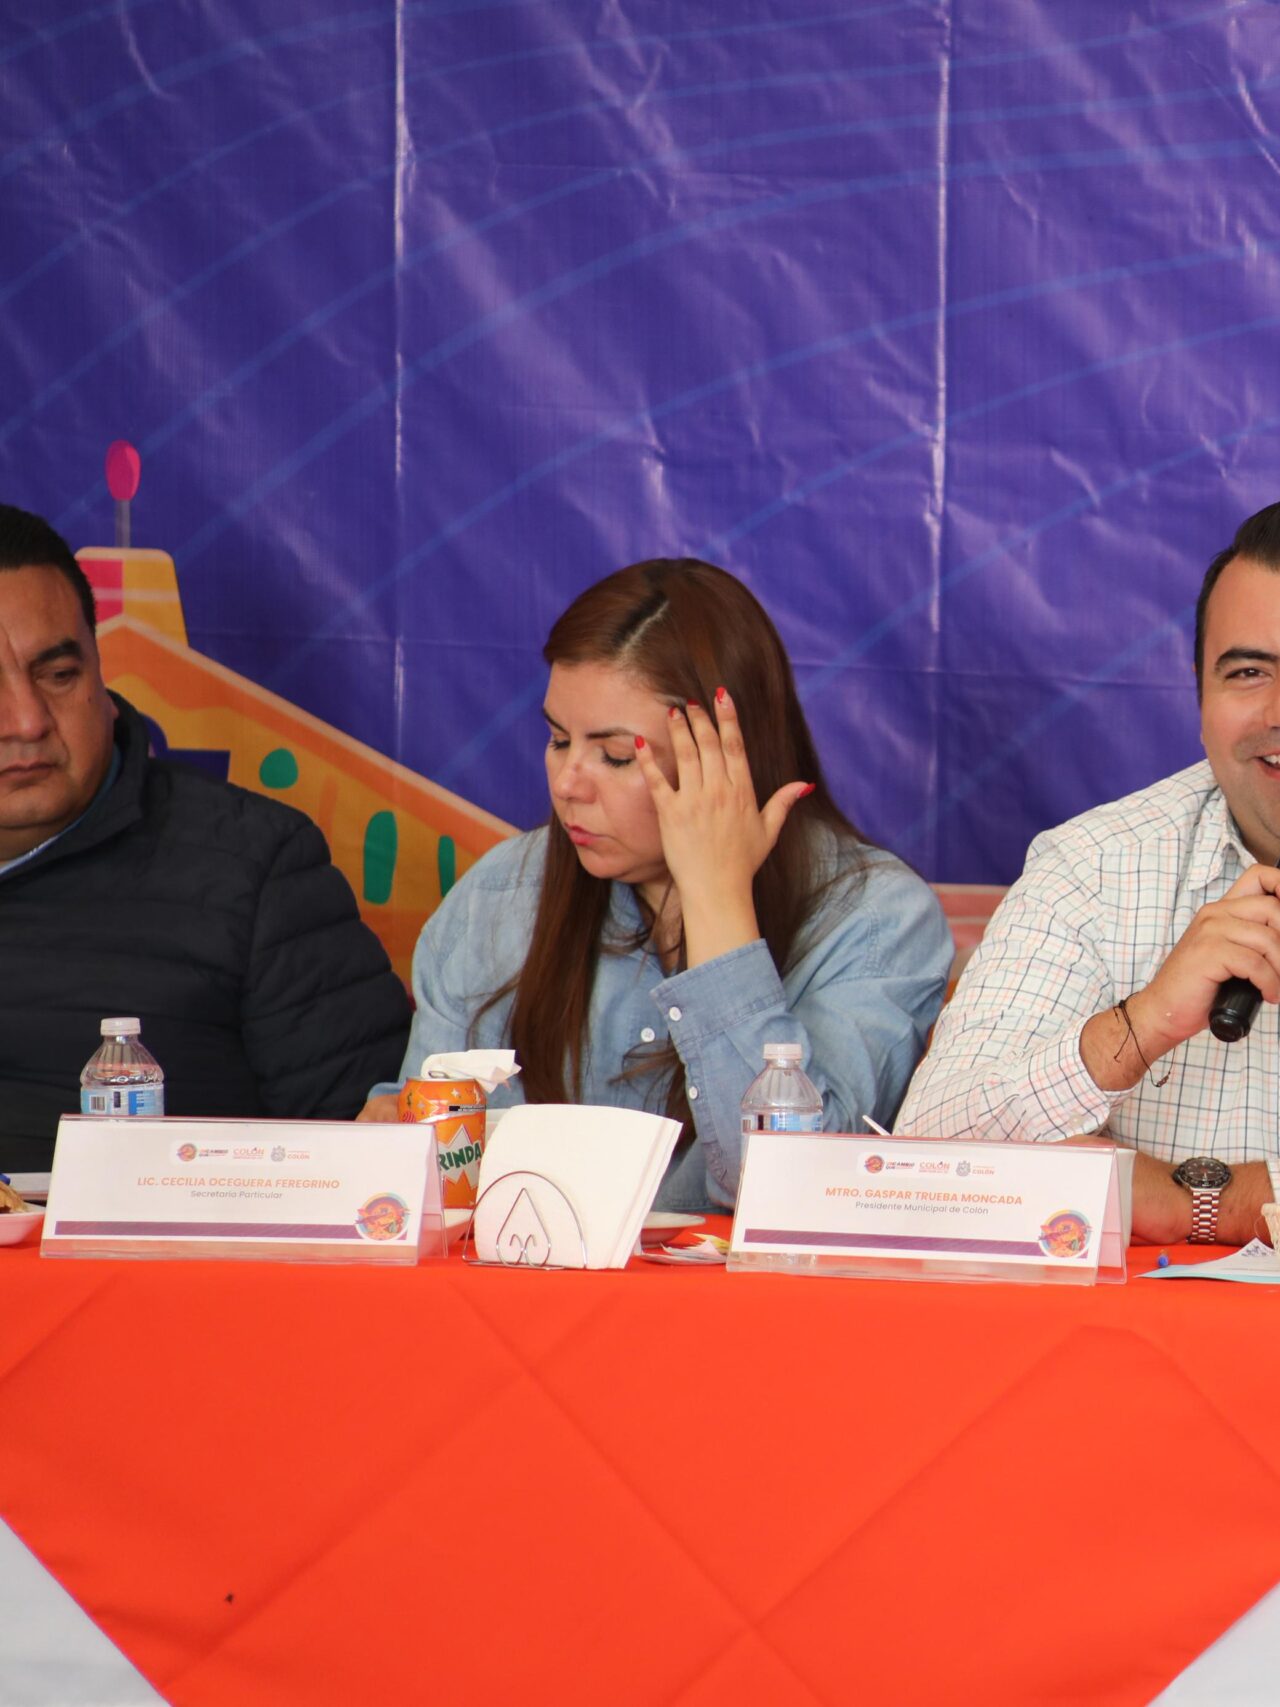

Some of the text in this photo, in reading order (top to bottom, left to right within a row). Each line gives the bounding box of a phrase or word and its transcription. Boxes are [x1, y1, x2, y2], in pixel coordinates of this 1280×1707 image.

[437, 1141, 482, 1170] RINDA
[137, 1177, 340, 1189] LIC. CECILIA OCEGUERA FEREGRINO
[239, 1191, 283, 1199] Particular
[825, 1187, 1023, 1205] MTRO. GASPAR TRUEBA MONCADA
[855, 1201, 902, 1210] Presidente
[904, 1204, 947, 1213] Municipal
[962, 1206, 989, 1214] Colón
